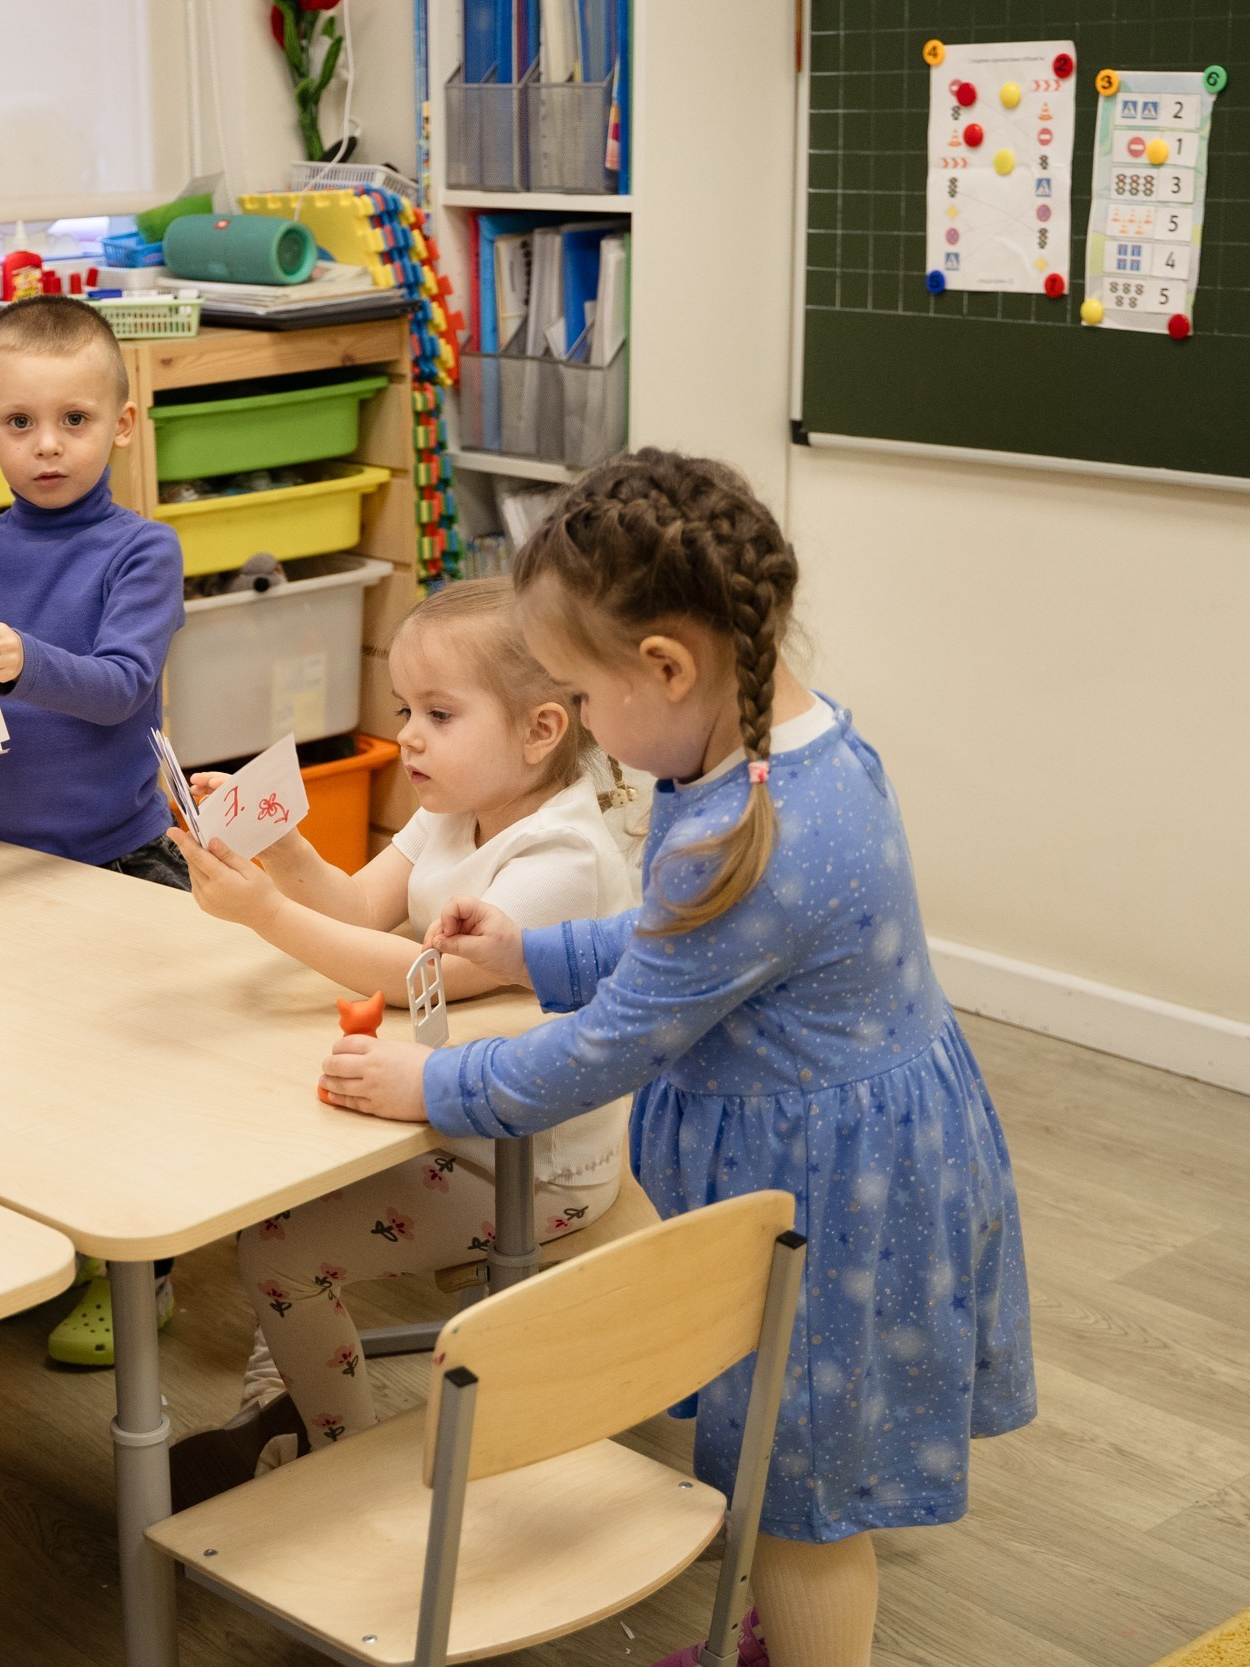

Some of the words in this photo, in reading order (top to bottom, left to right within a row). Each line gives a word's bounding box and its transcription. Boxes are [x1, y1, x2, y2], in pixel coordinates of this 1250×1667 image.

[1057, 57, 1068, 72] 2
[1101, 75, 1112, 89] 3
[1207, 72, 1219, 86] 6
[1173, 101, 1183, 119] 2
[1176, 137, 1182, 155] 1
[1171, 176, 1181, 194] 3
[1168, 215, 1178, 232] 5
[1165, 251, 1175, 269] 4
[1158, 288, 1169, 305] 5
